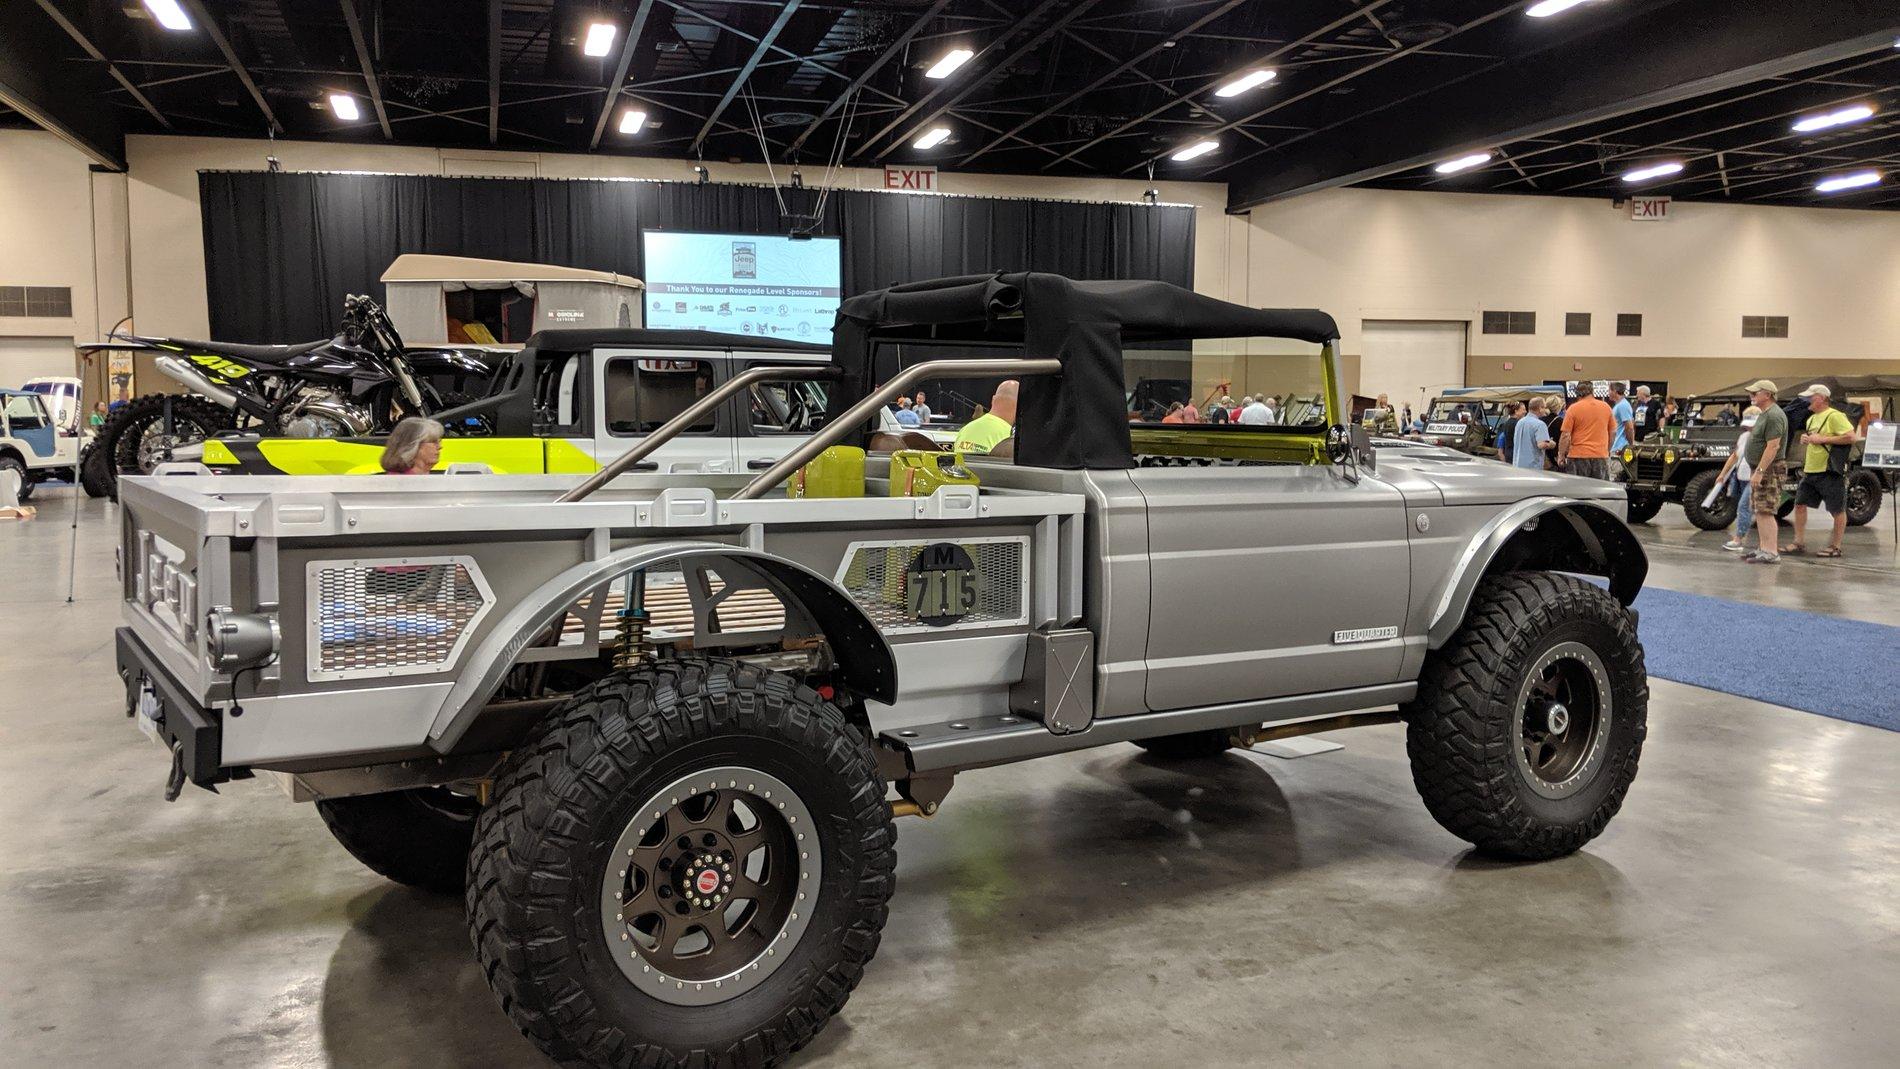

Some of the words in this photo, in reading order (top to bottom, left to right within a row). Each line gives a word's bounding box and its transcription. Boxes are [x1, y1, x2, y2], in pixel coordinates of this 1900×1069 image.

[886, 170, 936, 189] EXIT
[1632, 200, 1670, 216] EXIT
[666, 285, 689, 293] Thank
[729, 287, 765, 296] Renegade
[787, 289, 822, 297] Sponsors!
[190, 355, 251, 379] 419
[934, 546, 954, 564] M
[912, 575, 976, 612] 715
